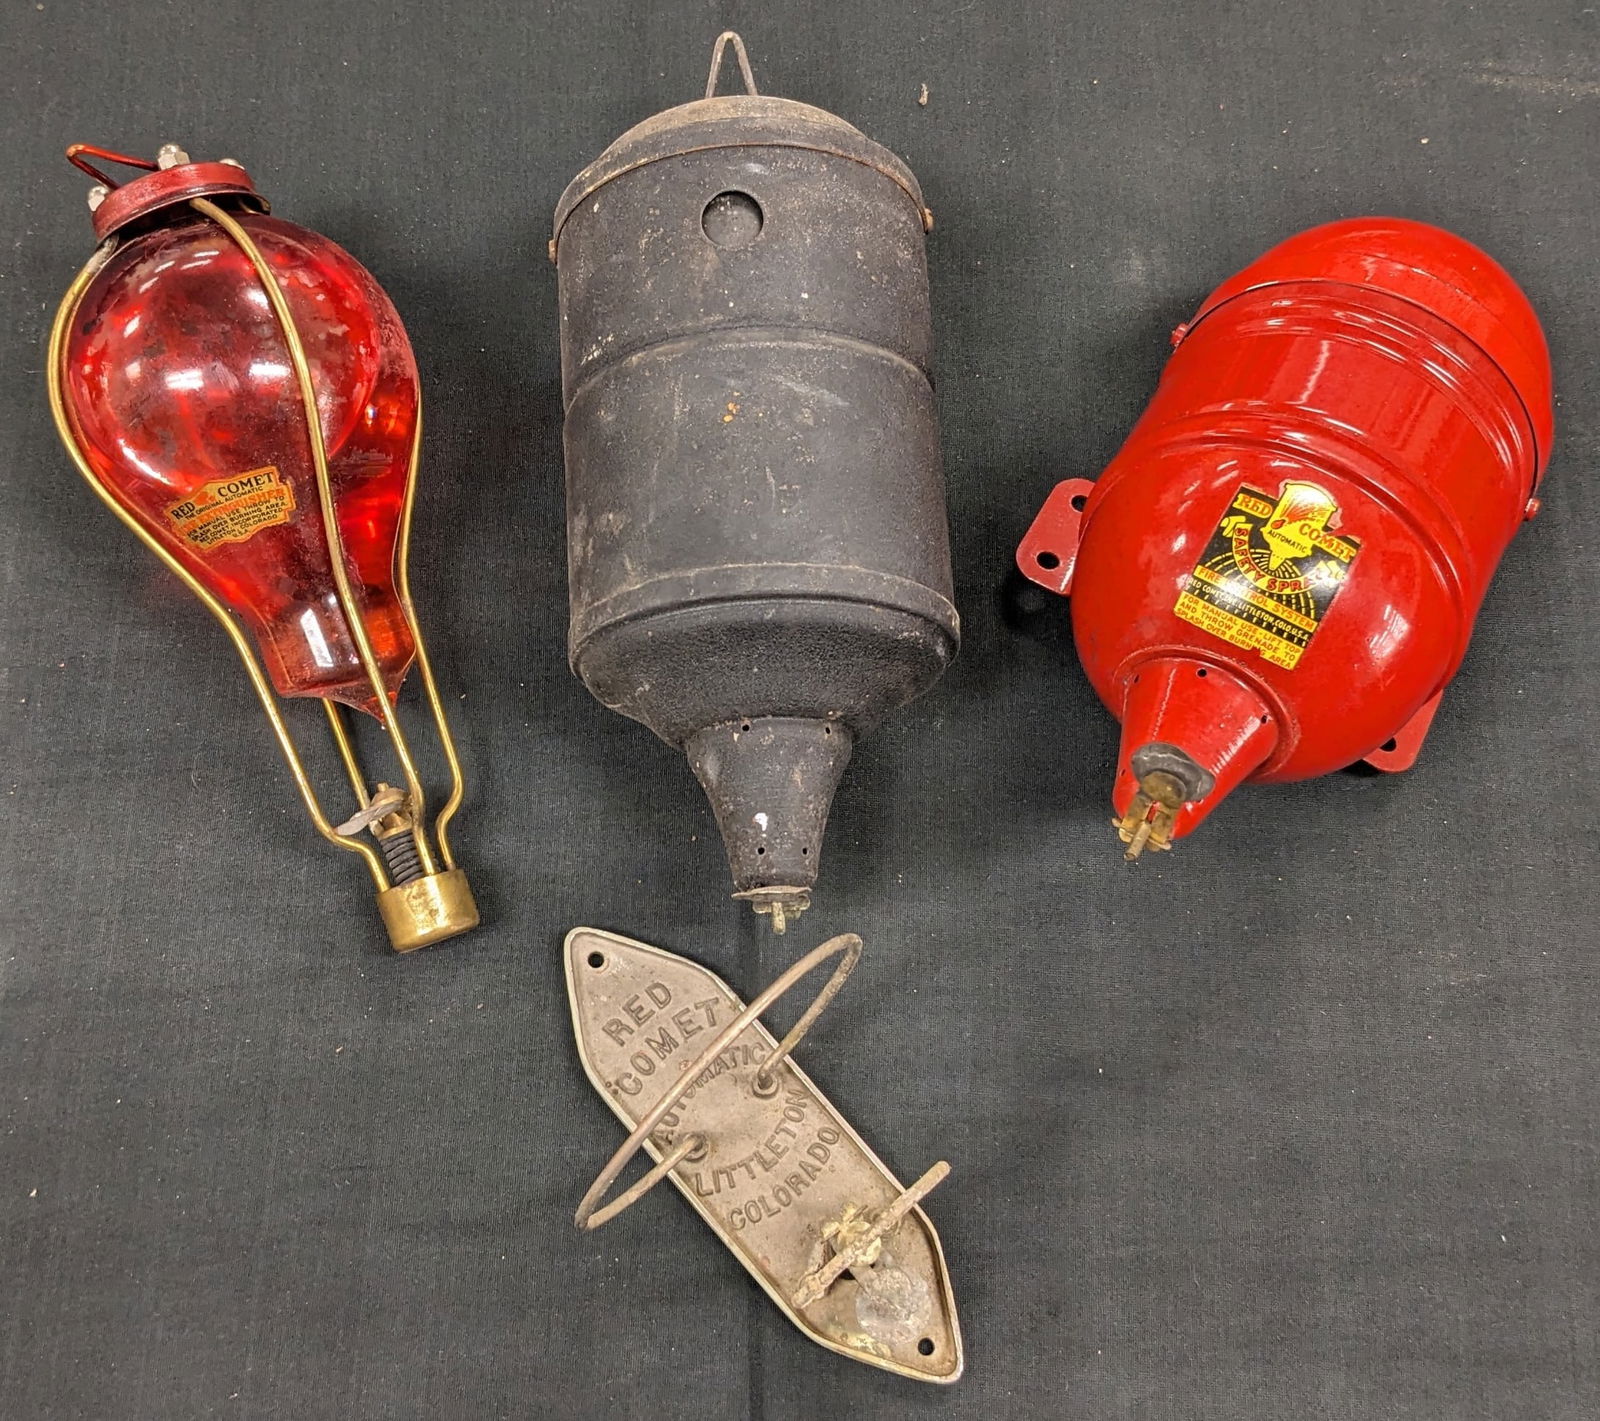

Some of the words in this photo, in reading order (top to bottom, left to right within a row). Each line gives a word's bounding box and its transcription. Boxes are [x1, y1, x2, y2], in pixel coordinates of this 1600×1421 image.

[171, 502, 196, 520] RED
[217, 472, 274, 497] COMET
[195, 500, 224, 514] ORIGINAL
[225, 486, 263, 502] AUTOMATIC
[212, 520, 228, 530] OVER
[229, 507, 262, 522] BURNING
[225, 508, 240, 518] USE
[244, 499, 271, 511] THROW
[231, 507, 283, 527] INCORPORATED
[240, 514, 278, 530] COLORADO
[1234, 528, 1267, 582] SAFETY
[1236, 494, 1273, 517] RED
[1299, 523, 1355, 561] COMET
[1267, 530, 1308, 553] AUTOMATIC
[1183, 594, 1200, 606] FOR
[1201, 603, 1238, 626] MANUAL
[1284, 643, 1301, 654] TOP
[1198, 568, 1220, 585] FIRE
[1272, 604, 1315, 630] SYSTEM
[1177, 608, 1204, 627] SPLASH
[1206, 623, 1227, 638] OVER
[1269, 654, 1292, 669] AREA
[1180, 602, 1198, 614] AND
[1201, 611, 1234, 631] THROW
[1236, 629, 1280, 654] GRENADE
[1284, 651, 1296, 661] TO
[601, 981, 673, 1048] RED
[615, 996, 720, 1097] COMET
[694, 1088, 808, 1198] LITTLETON
[729, 1126, 841, 1232] COLORADO
